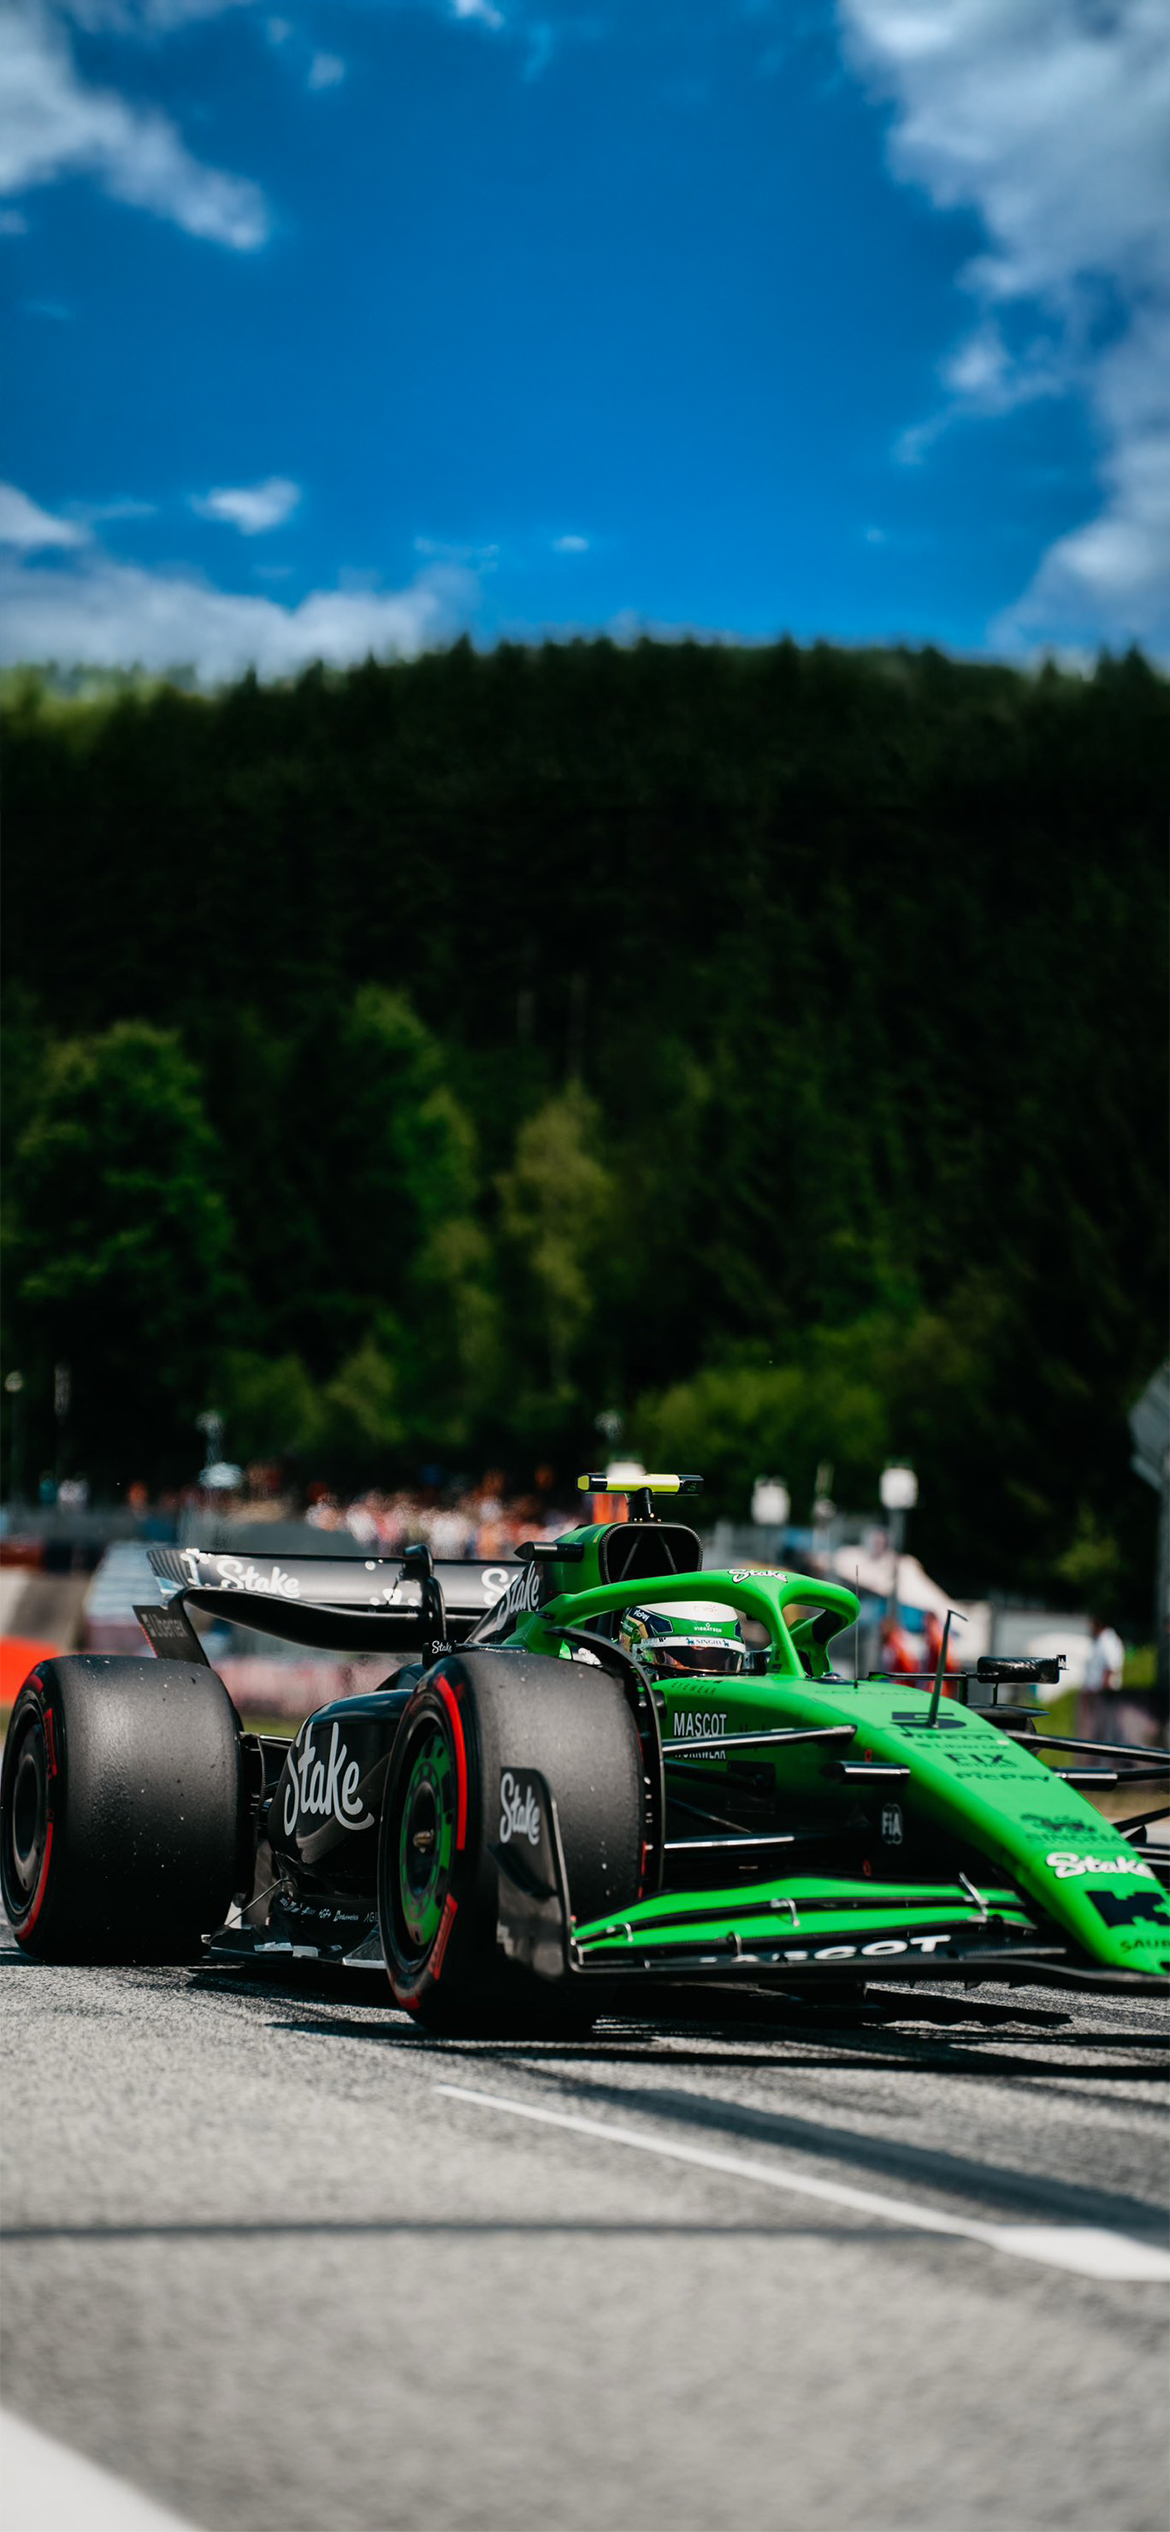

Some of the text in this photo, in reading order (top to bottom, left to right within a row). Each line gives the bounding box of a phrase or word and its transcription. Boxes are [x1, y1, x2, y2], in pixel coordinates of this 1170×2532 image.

[217, 1559, 301, 1599] Stake
[496, 1562, 540, 1631] Stake
[431, 1640, 453, 1654] Stake
[674, 1712, 727, 1738] MASCOT
[284, 1721, 375, 1837] Stake
[500, 1772, 541, 1846] Stake
